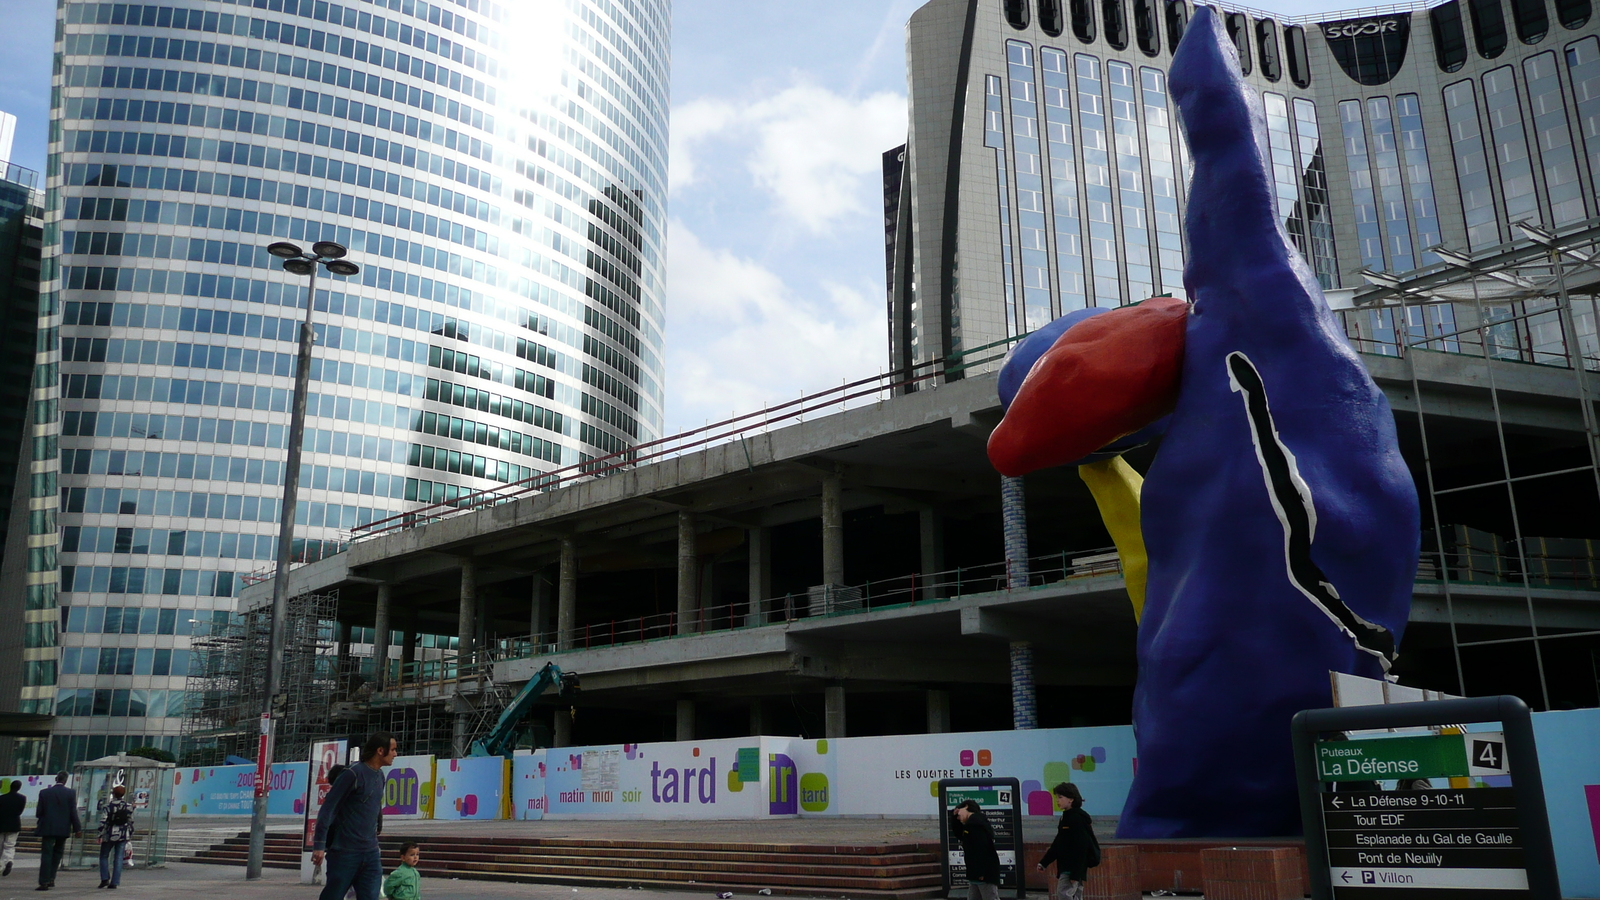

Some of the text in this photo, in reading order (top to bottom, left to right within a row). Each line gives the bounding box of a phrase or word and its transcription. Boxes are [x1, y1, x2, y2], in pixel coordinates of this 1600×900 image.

[1326, 20, 1398, 39] SCOR
[1321, 747, 1363, 757] Puteaux
[1479, 743, 1497, 767] 4
[895, 770, 911, 779] LES
[960, 768, 994, 778] TEMPS
[1321, 757, 1419, 776] La Défense
[382, 768, 416, 806] oir
[651, 757, 716, 804] tard
[559, 788, 585, 804] matin
[621, 787, 642, 803] soir
[802, 786, 827, 803] tard
[1002, 794, 1009, 802] 4
[1351, 794, 1466, 807] La Défense 9-10-11
[1353, 814, 1405, 826] Tour EDF
[1355, 834, 1412, 847] Esplanade
[1415, 833, 1430, 845] du
[1456, 833, 1472, 844] de
[1475, 832, 1513, 844] Gaulle
[1358, 852, 1443, 866] Pont de Neuilly
[1379, 872, 1414, 884] Villon
